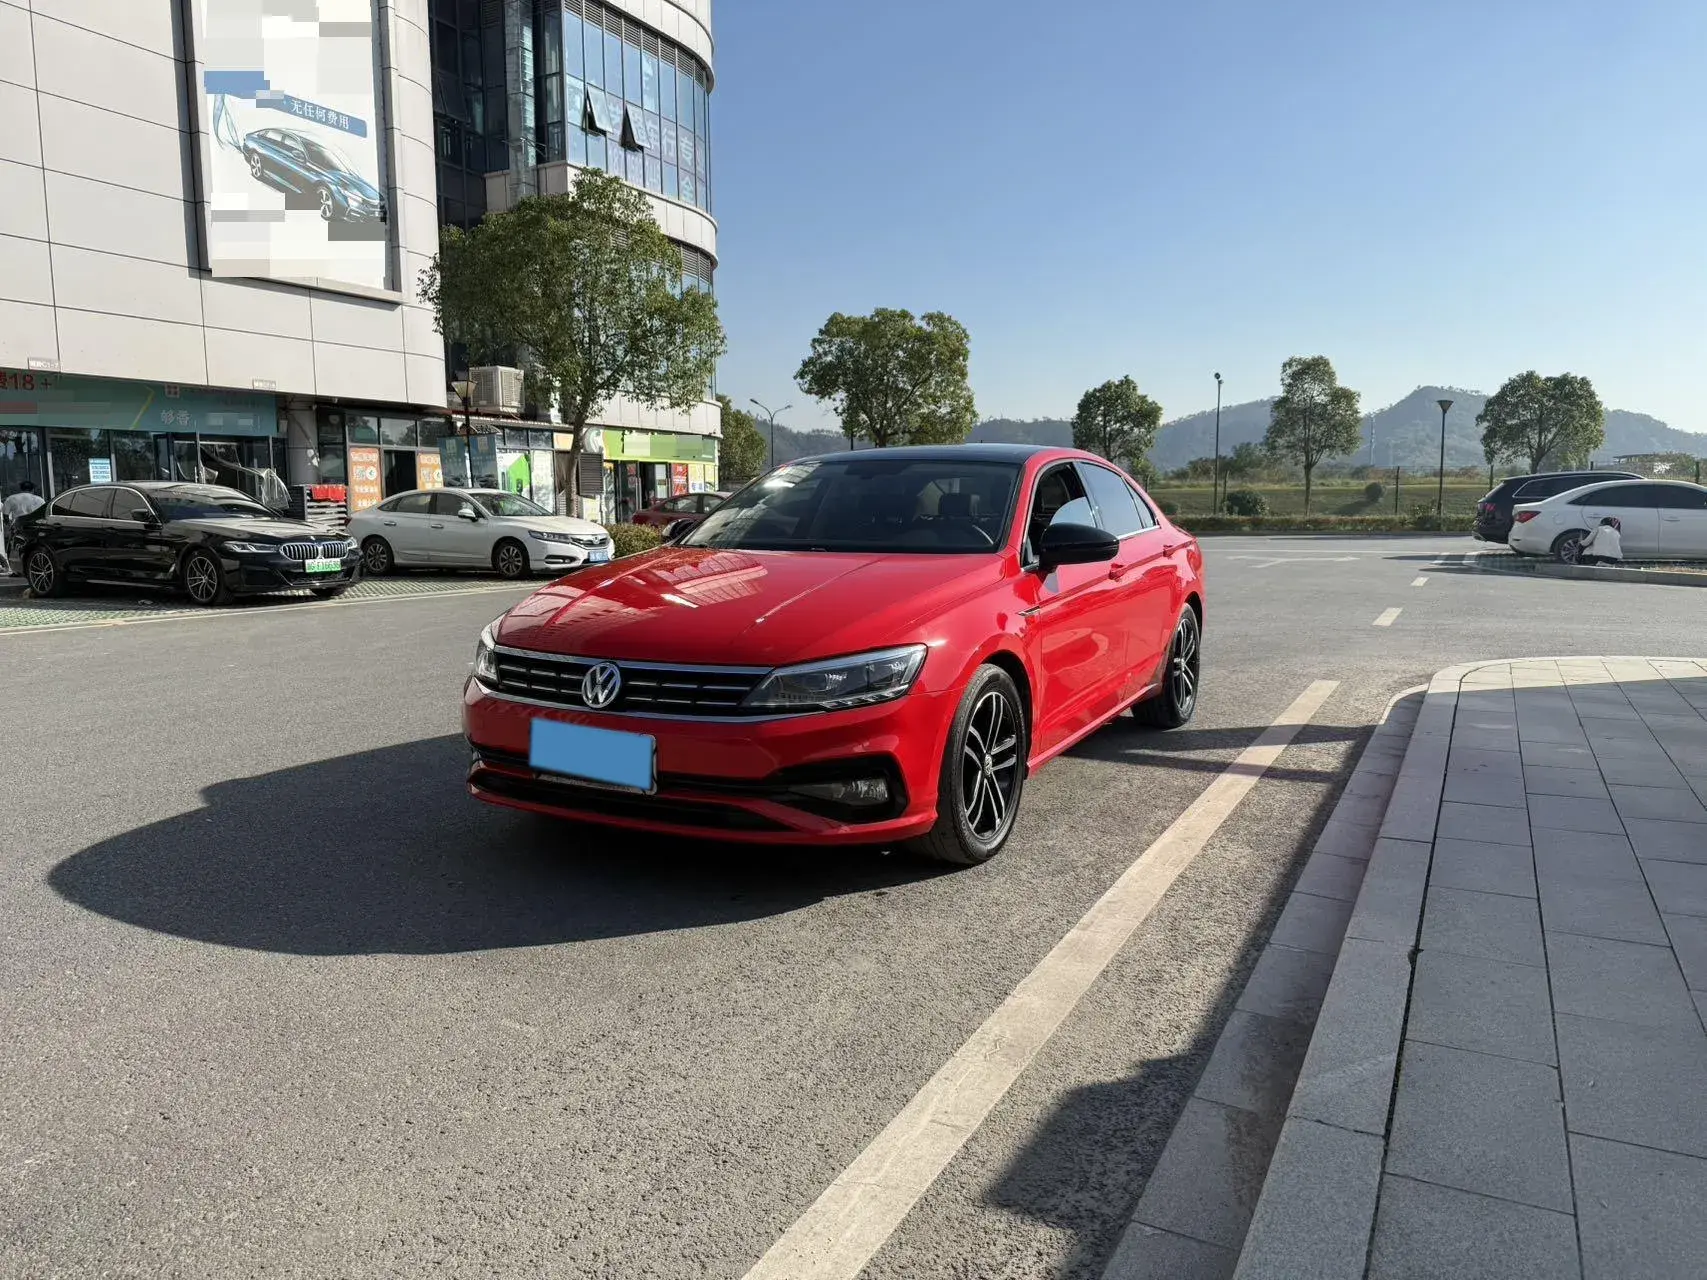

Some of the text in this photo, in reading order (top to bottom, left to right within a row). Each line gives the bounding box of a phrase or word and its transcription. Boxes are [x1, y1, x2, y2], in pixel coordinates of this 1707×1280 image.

[291, 99, 350, 130] 无任何费用
